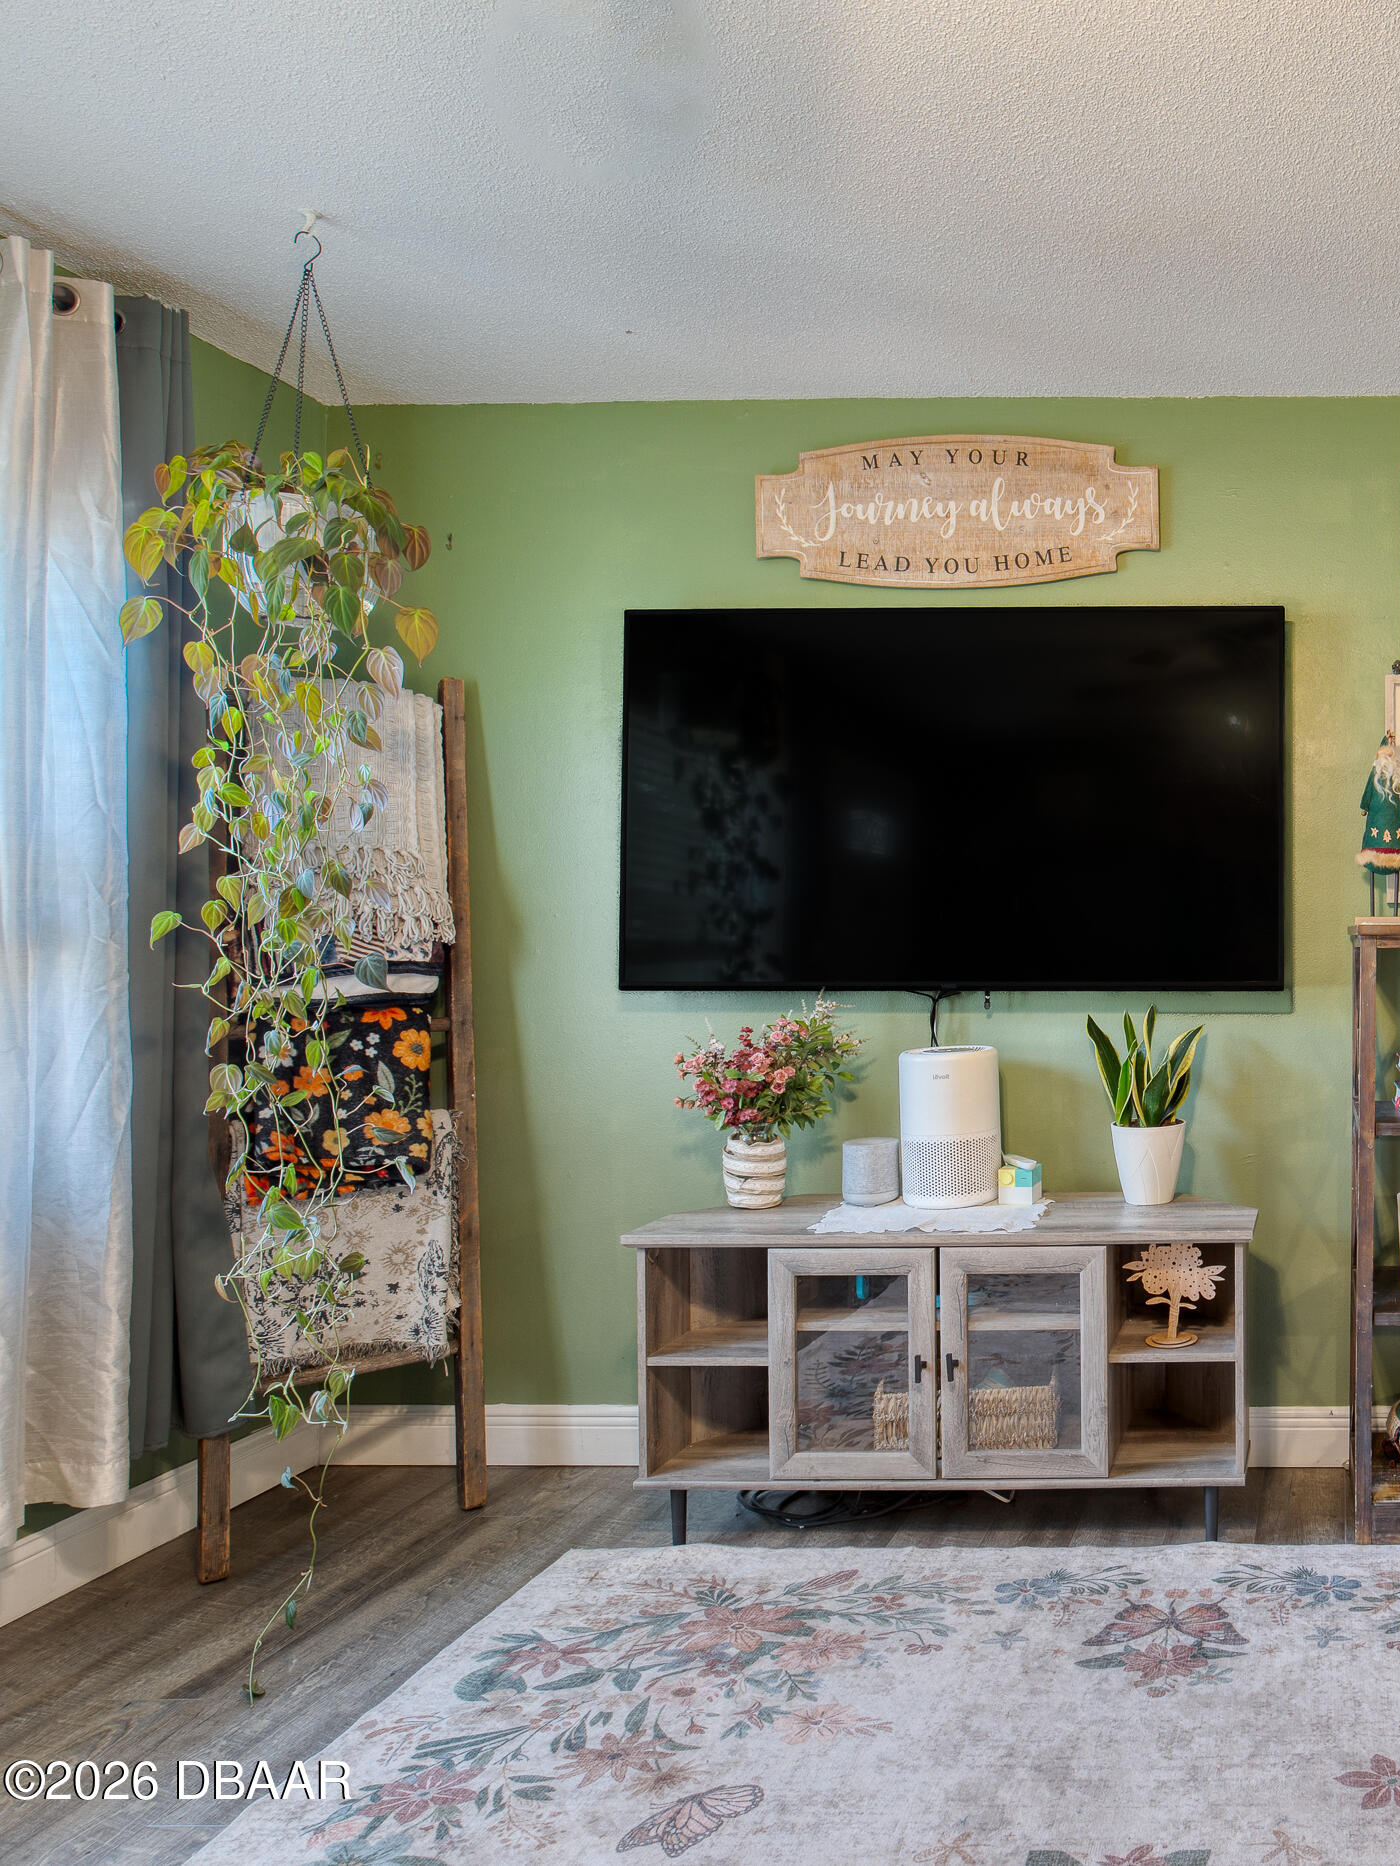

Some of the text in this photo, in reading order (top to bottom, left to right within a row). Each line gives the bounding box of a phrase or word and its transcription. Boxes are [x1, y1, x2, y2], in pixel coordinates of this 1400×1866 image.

[861, 448, 1030, 471] MAY YOUR
[810, 476, 1108, 541] Journey always
[838, 546, 1074, 575] LEAD YOU HOME
